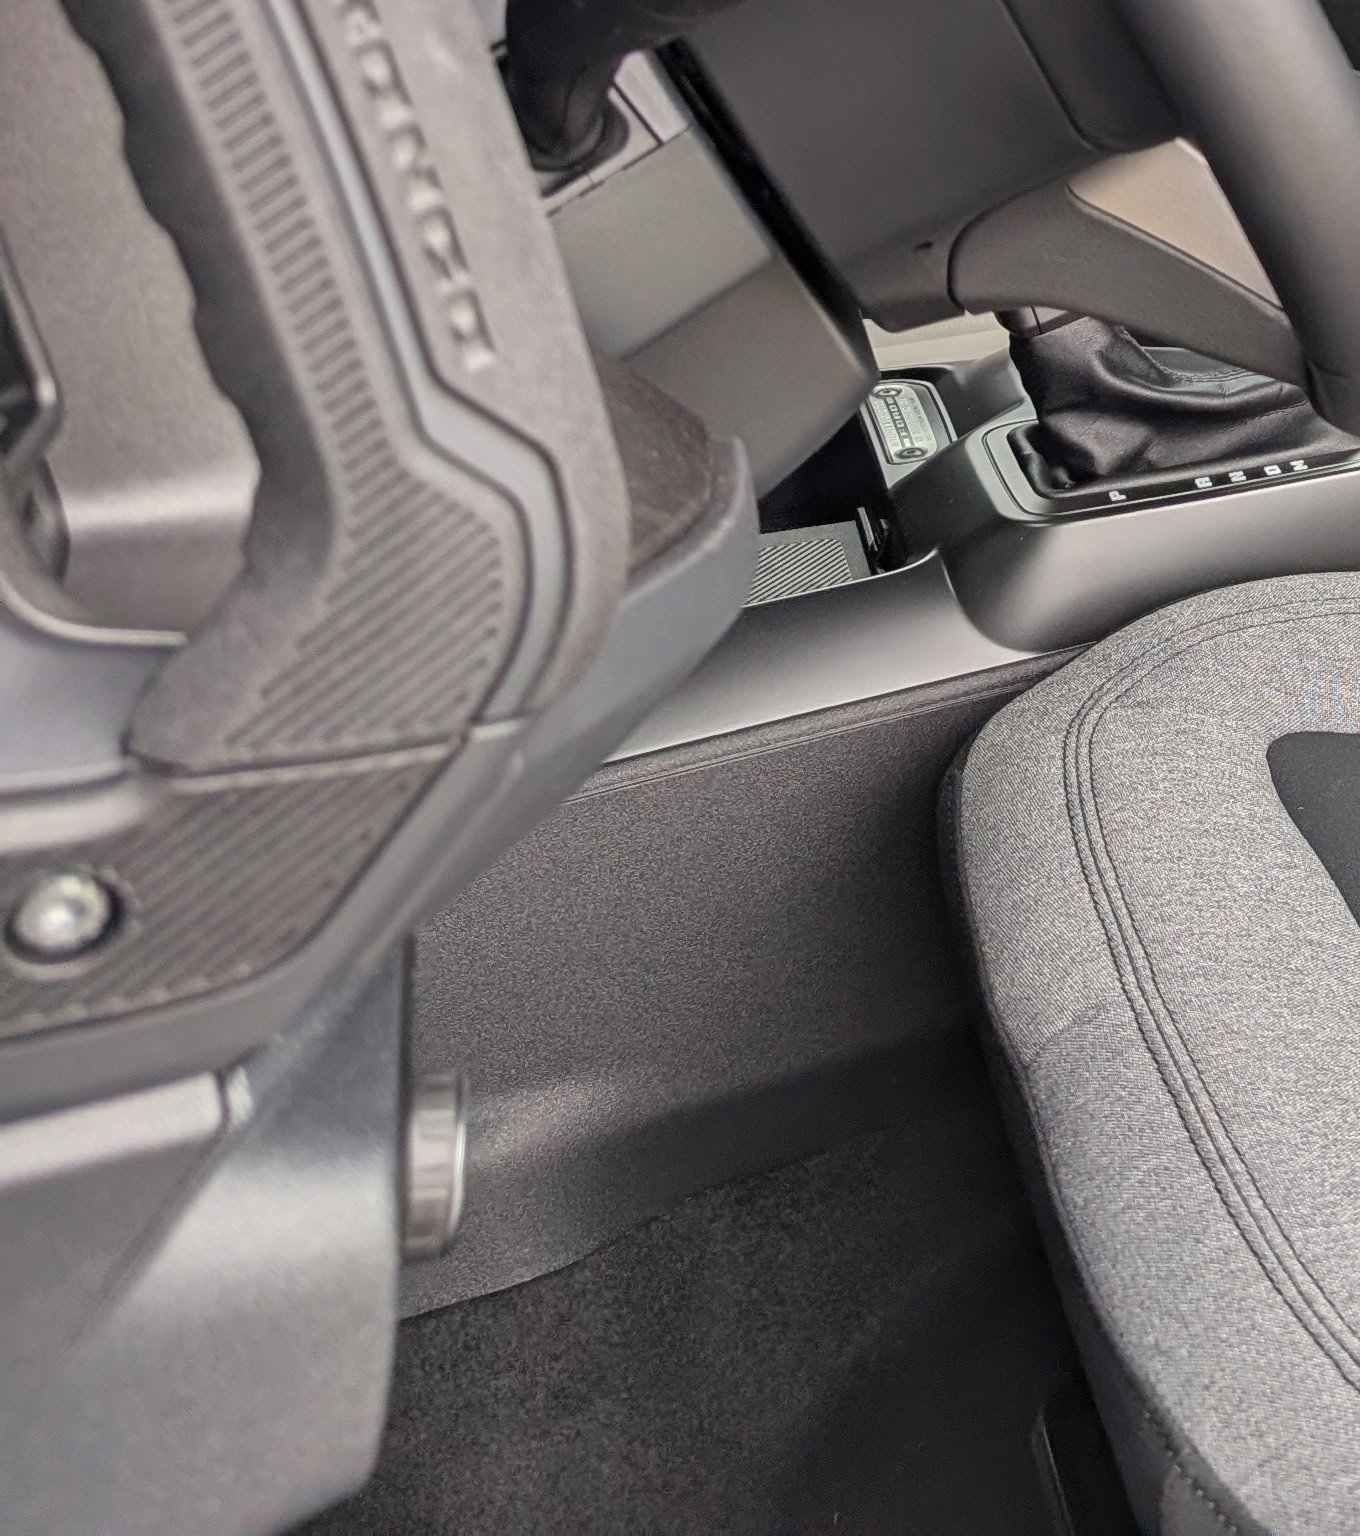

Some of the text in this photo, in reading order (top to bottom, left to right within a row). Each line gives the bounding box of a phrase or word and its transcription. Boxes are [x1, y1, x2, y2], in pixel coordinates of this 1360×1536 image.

[888, 404, 909, 437] FORD
[1108, 459, 1309, 502] P R N D M
